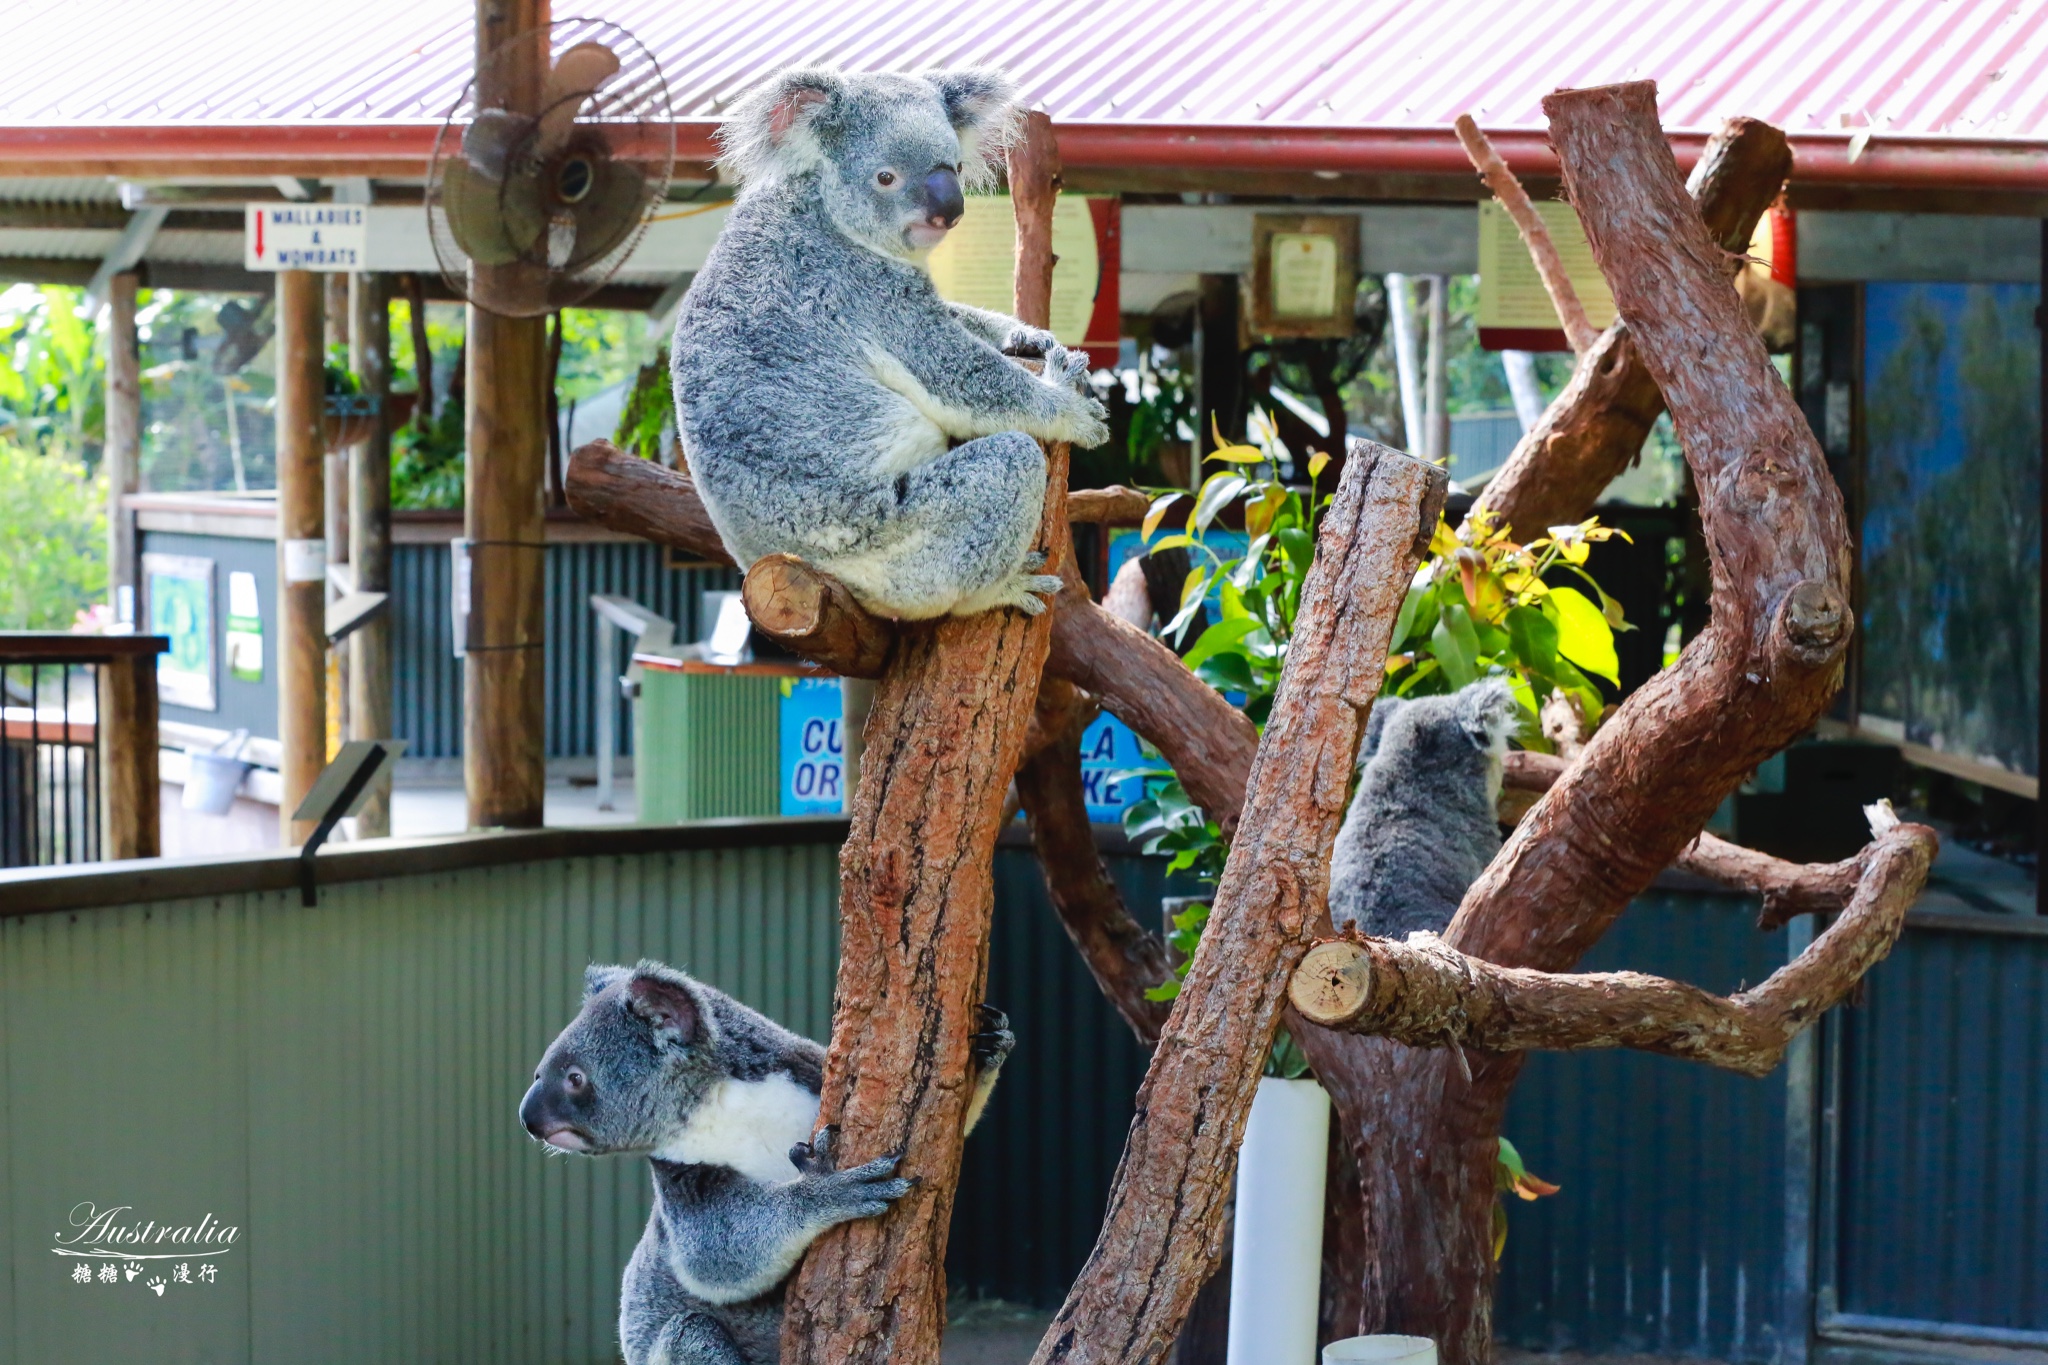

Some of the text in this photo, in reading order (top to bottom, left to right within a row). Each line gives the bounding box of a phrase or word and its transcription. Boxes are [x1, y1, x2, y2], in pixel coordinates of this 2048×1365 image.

[272, 210, 362, 224] WALLABIES
[311, 230, 321, 245] &
[278, 250, 357, 265] WOMBATS
